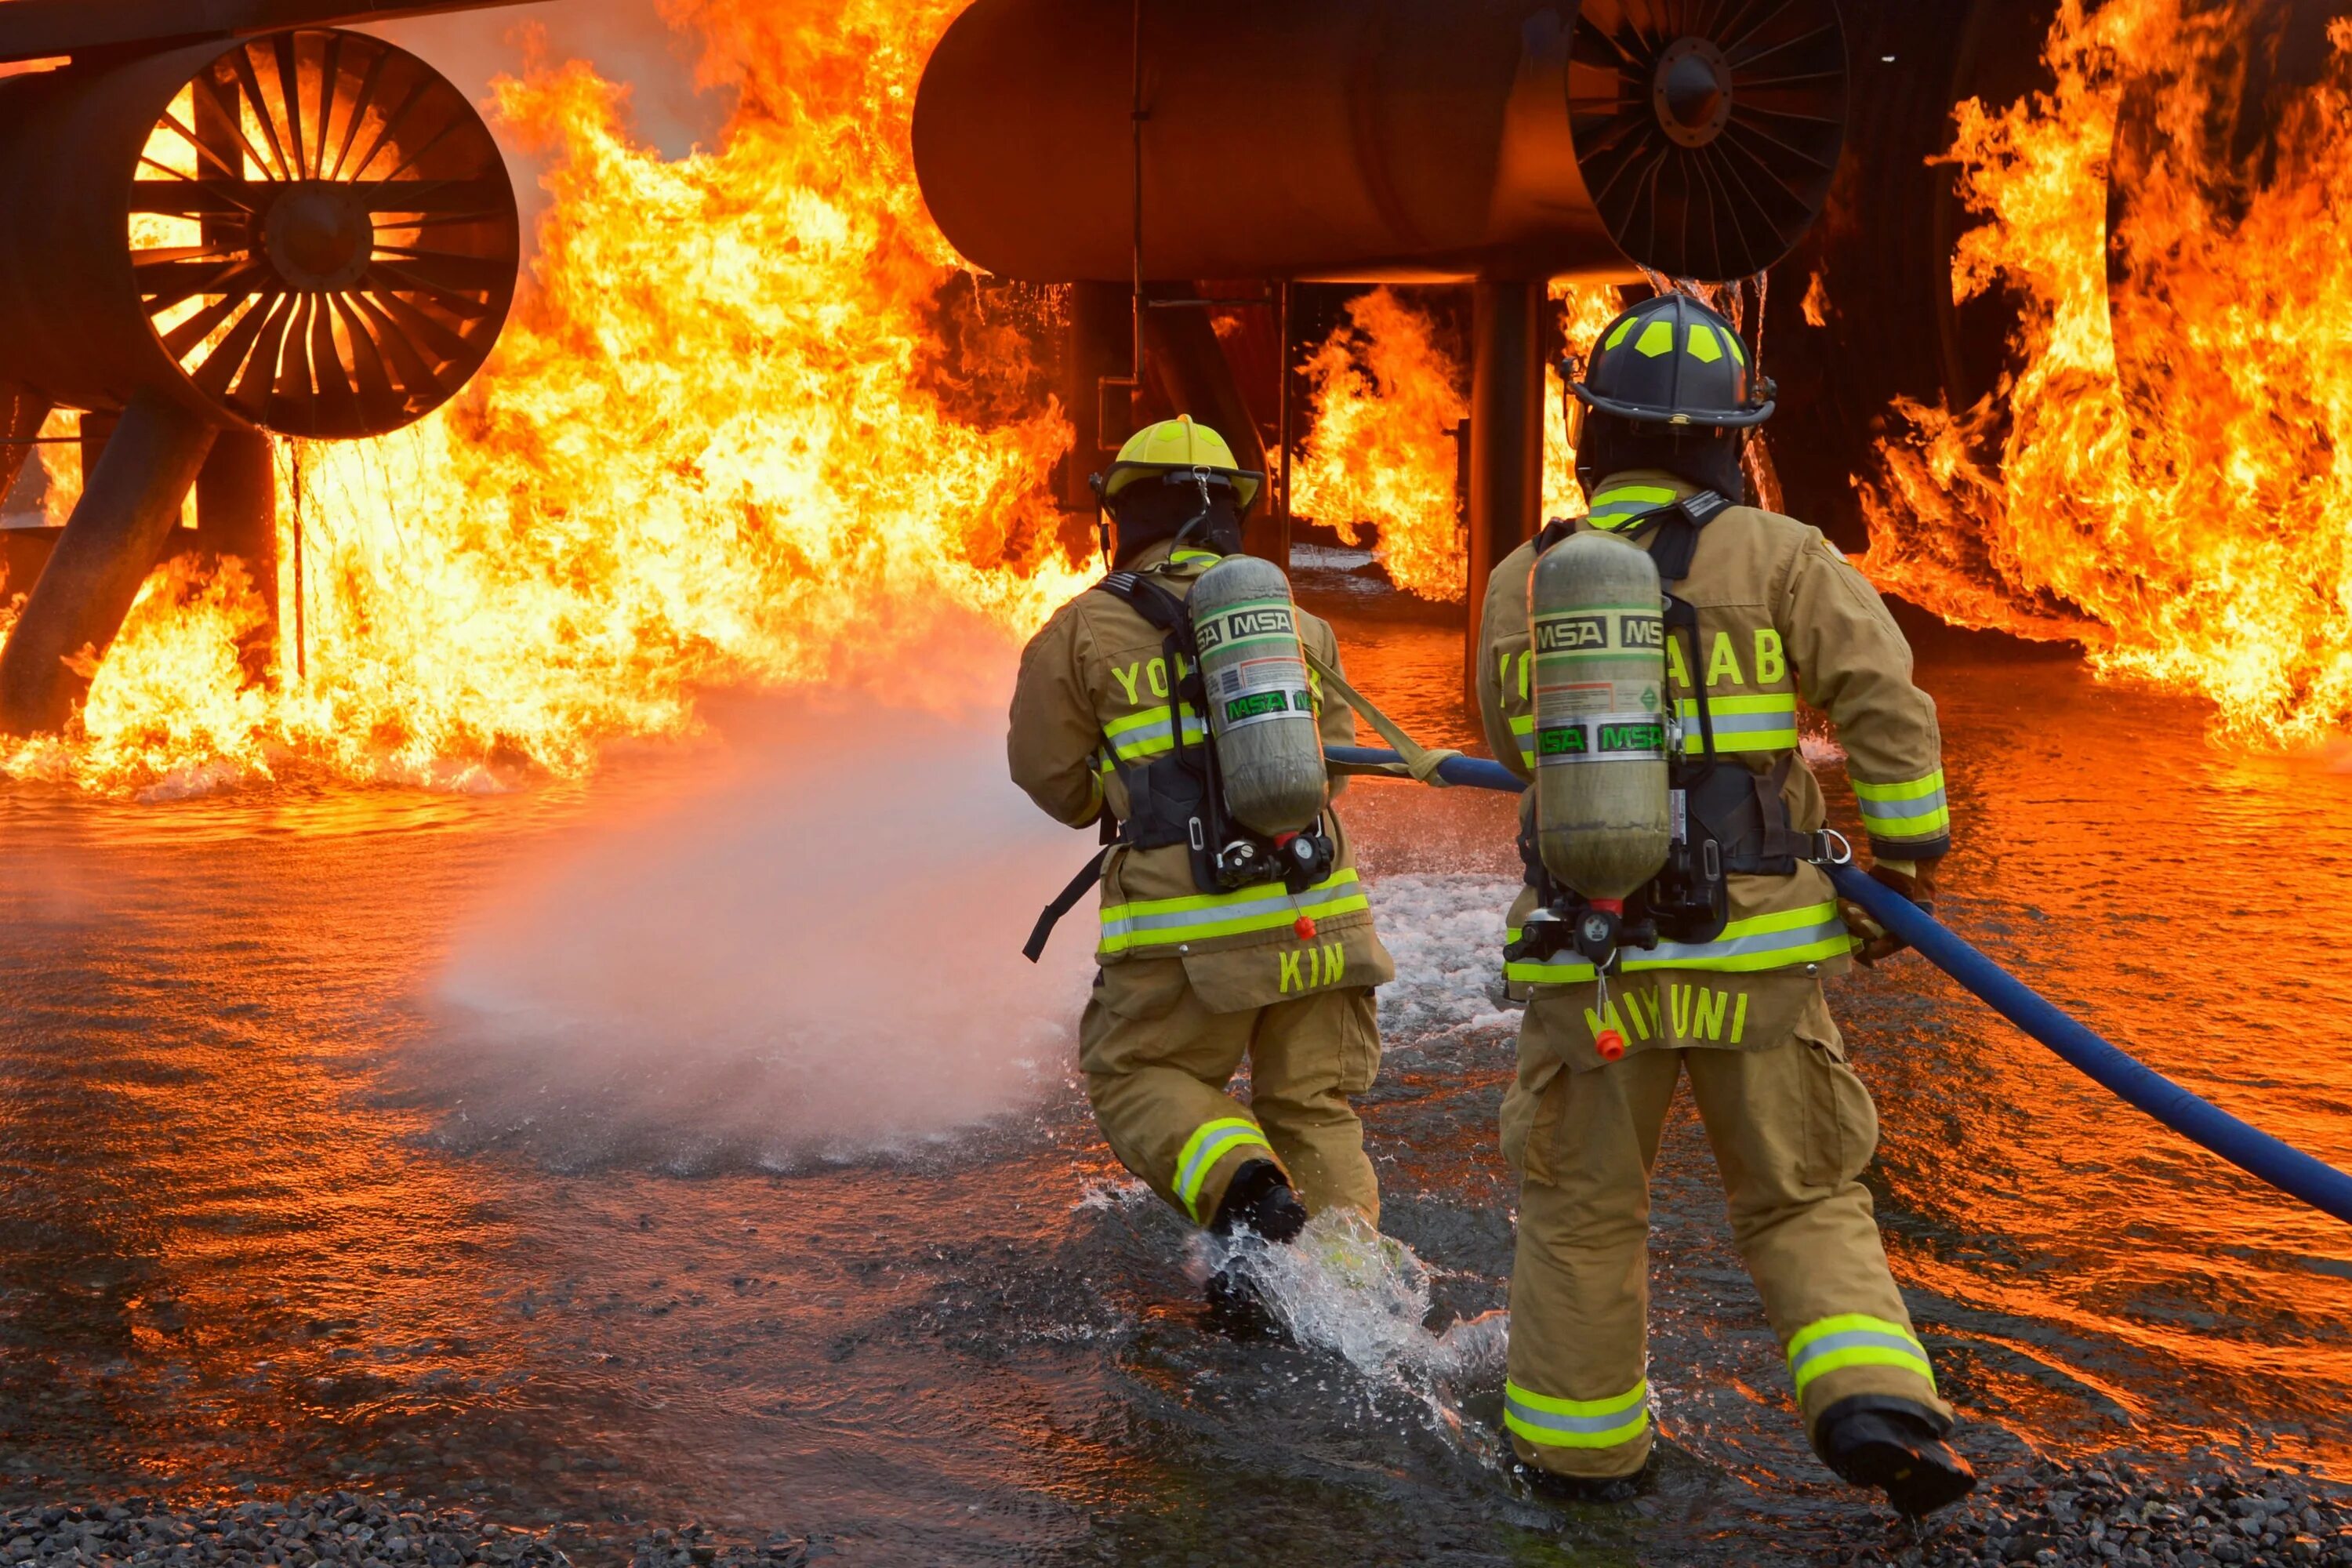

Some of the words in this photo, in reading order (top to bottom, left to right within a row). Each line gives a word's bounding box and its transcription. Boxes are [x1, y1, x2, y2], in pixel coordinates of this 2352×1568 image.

[1234, 612, 1292, 636] MSA
[1537, 621, 1604, 649] MSA
[1228, 692, 1287, 720] MSA
[1602, 726, 1663, 750] MSA
[1279, 942, 1345, 993] KIN
